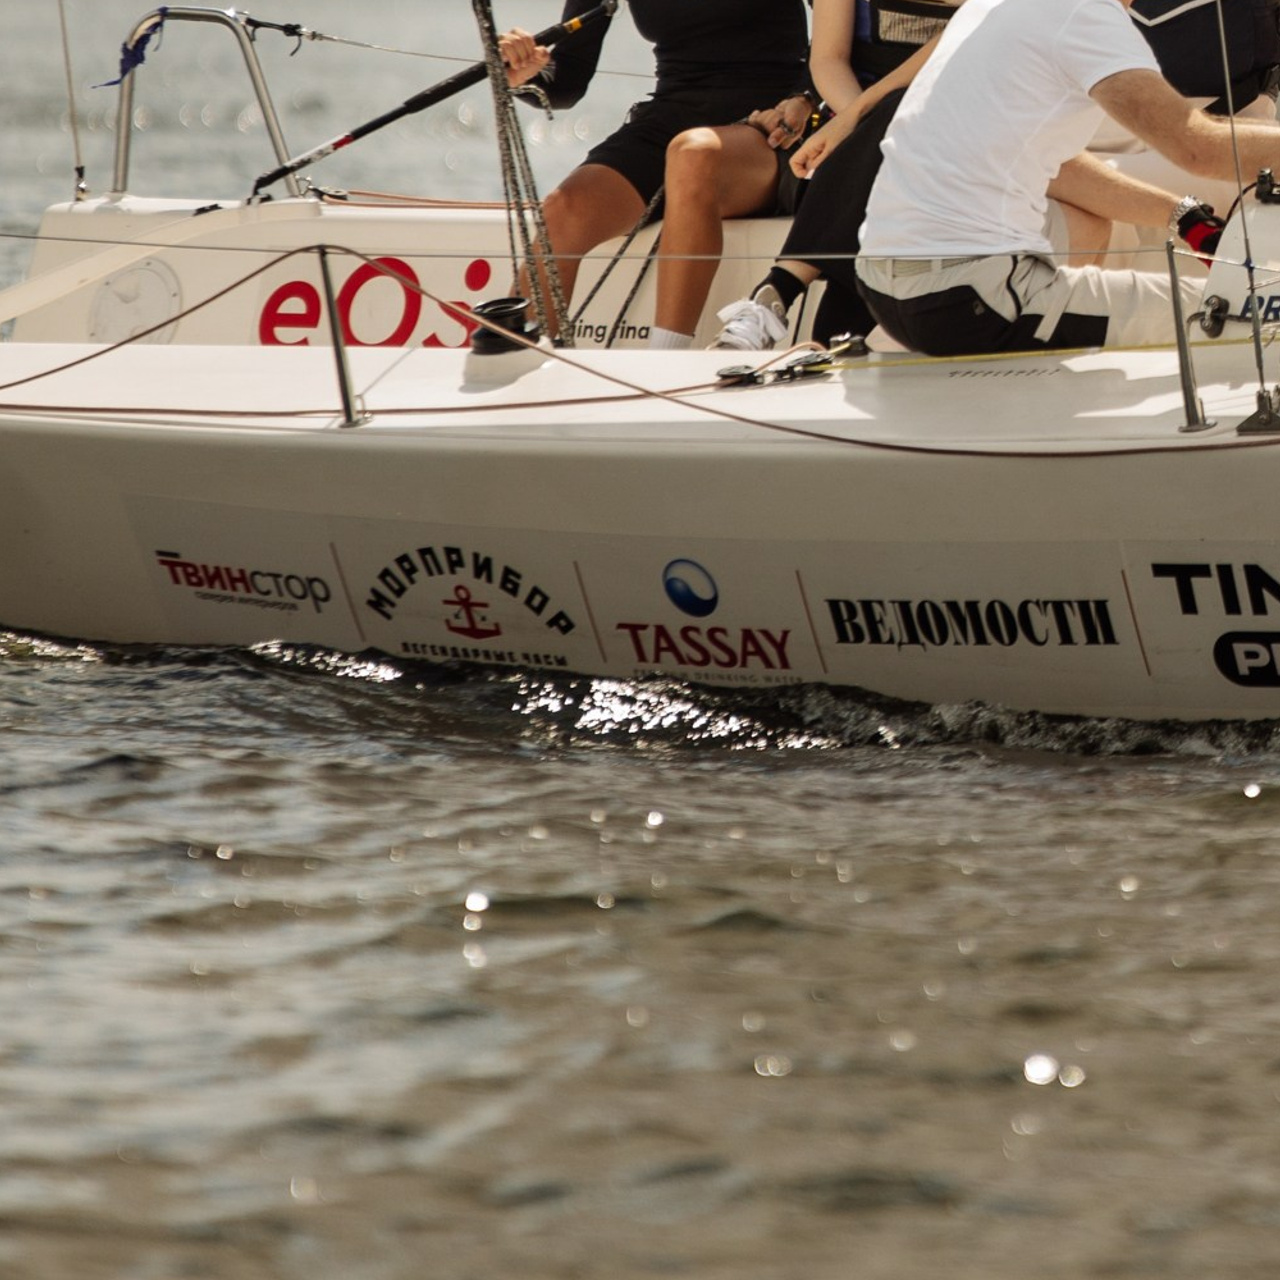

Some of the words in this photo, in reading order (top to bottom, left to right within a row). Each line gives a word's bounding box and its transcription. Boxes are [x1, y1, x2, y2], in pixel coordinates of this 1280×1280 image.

[366, 546, 576, 635] МОРПРИБОР
[616, 623, 791, 669] TASSAY
[824, 597, 1119, 652] ВЕДОМОСТИ
